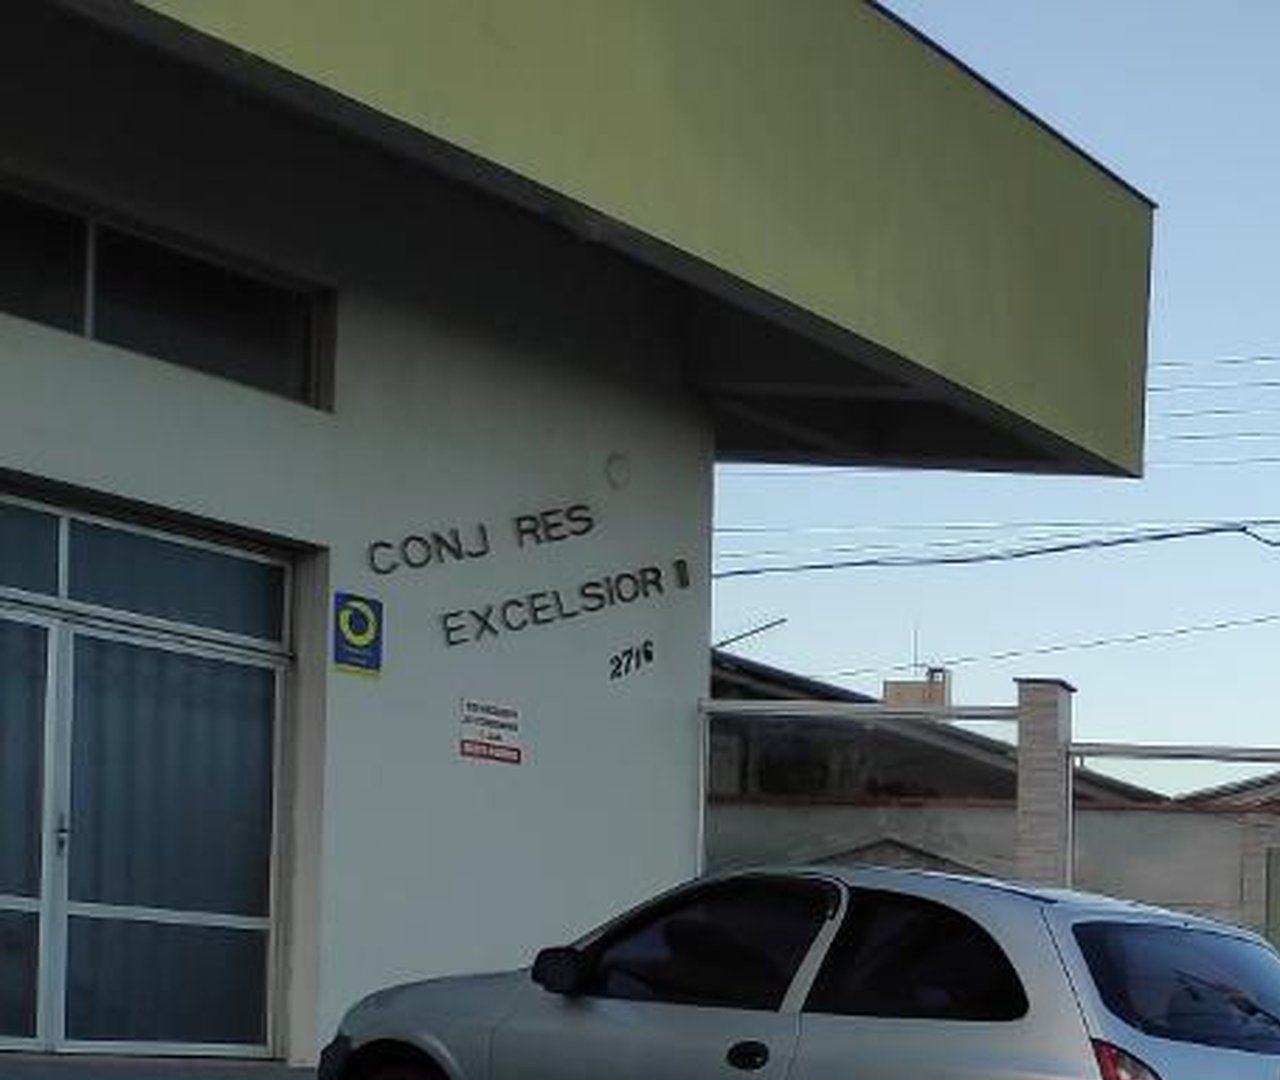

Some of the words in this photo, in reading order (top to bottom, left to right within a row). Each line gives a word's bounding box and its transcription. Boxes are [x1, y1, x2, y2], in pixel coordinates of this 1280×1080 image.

[369, 523, 491, 575] CONJ
[514, 504, 594, 549] RES
[442, 566, 664, 646] EXCELSIOR
[609, 640, 654, 680] 2716
